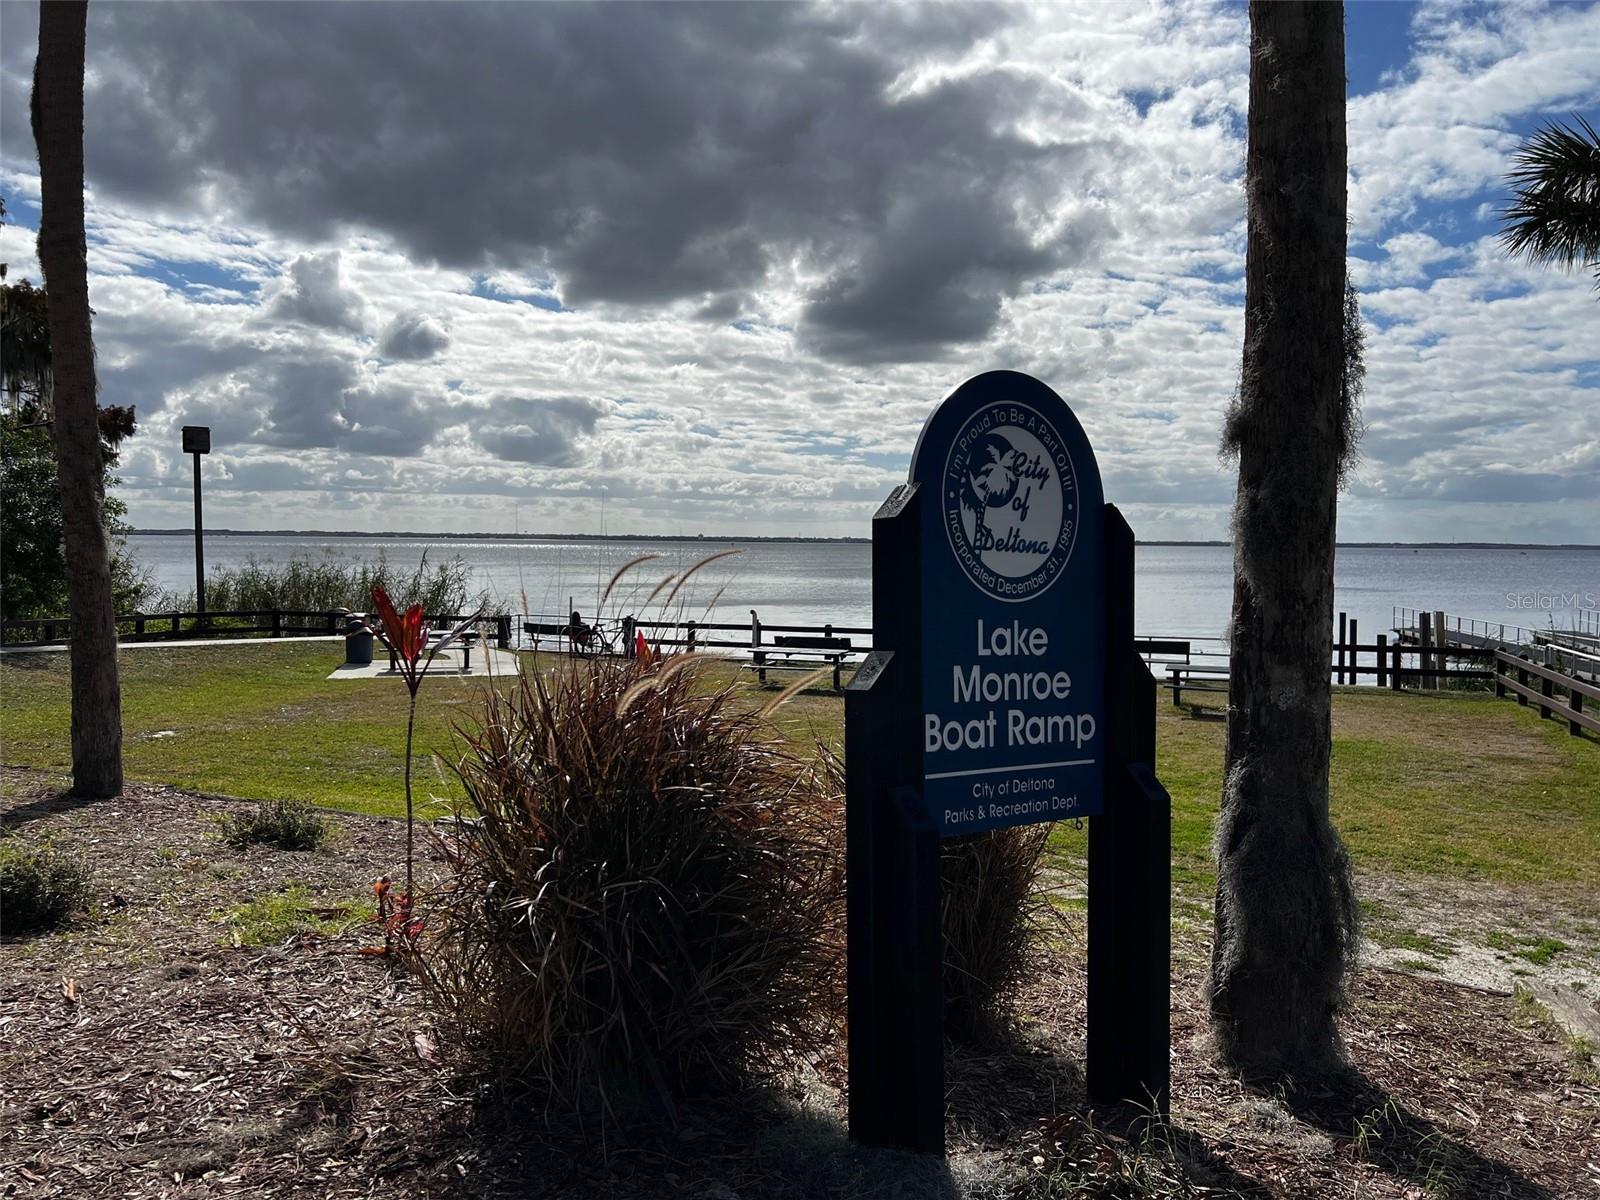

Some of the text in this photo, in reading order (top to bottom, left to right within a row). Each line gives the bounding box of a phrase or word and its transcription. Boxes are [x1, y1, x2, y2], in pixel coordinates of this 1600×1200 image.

[949, 454, 964, 479] I'm
[959, 414, 991, 452] Proud
[992, 409, 1007, 423] To
[1010, 408, 1025, 424] Be
[1027, 416, 1036, 430] A
[1038, 424, 1059, 453] Part
[1056, 453, 1069, 472] Of
[1012, 451, 1051, 491] City
[1012, 486, 1031, 522] of
[949, 509, 1073, 594] Incorporated December 31, 1995
[981, 525, 1050, 555] Deltona
[977, 618, 1049, 656] Lake
[953, 664, 1072, 703] Monroe
[924, 708, 1096, 753] Boat Ramp
[972, 778, 1055, 798] City of Deltona
[944, 794, 1080, 824] Parks & Recreation Dept.
